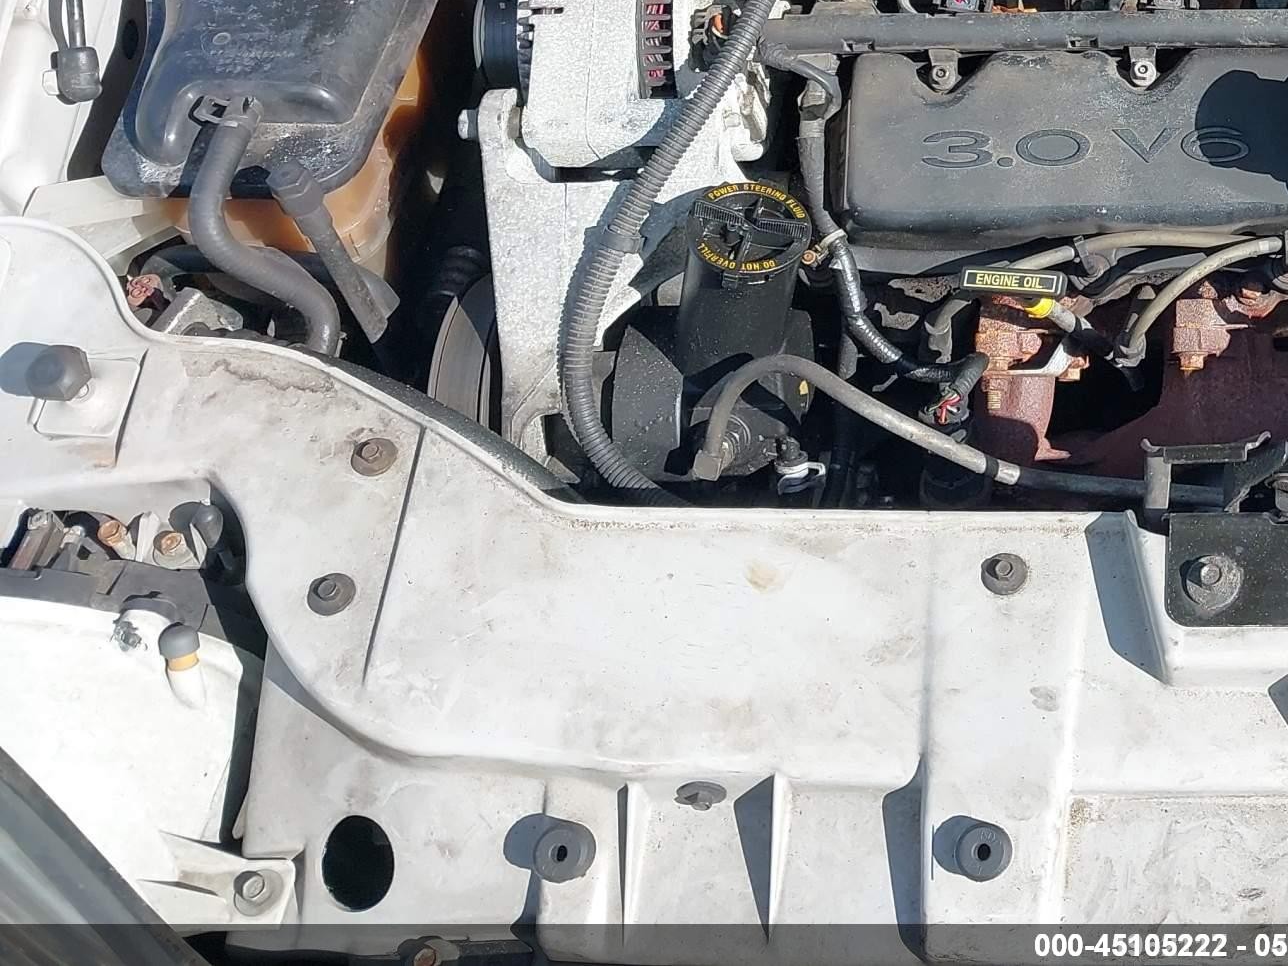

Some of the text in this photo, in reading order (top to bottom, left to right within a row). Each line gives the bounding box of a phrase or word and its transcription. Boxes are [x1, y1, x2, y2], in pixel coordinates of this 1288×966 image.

[921, 125, 1250, 169] 3.0 V6
[708, 183, 806, 220] POWER STEERING FLUID
[697, 241, 776, 271] DO NOT OVERFILL
[975, 273, 1043, 289] ENGINE OIL
